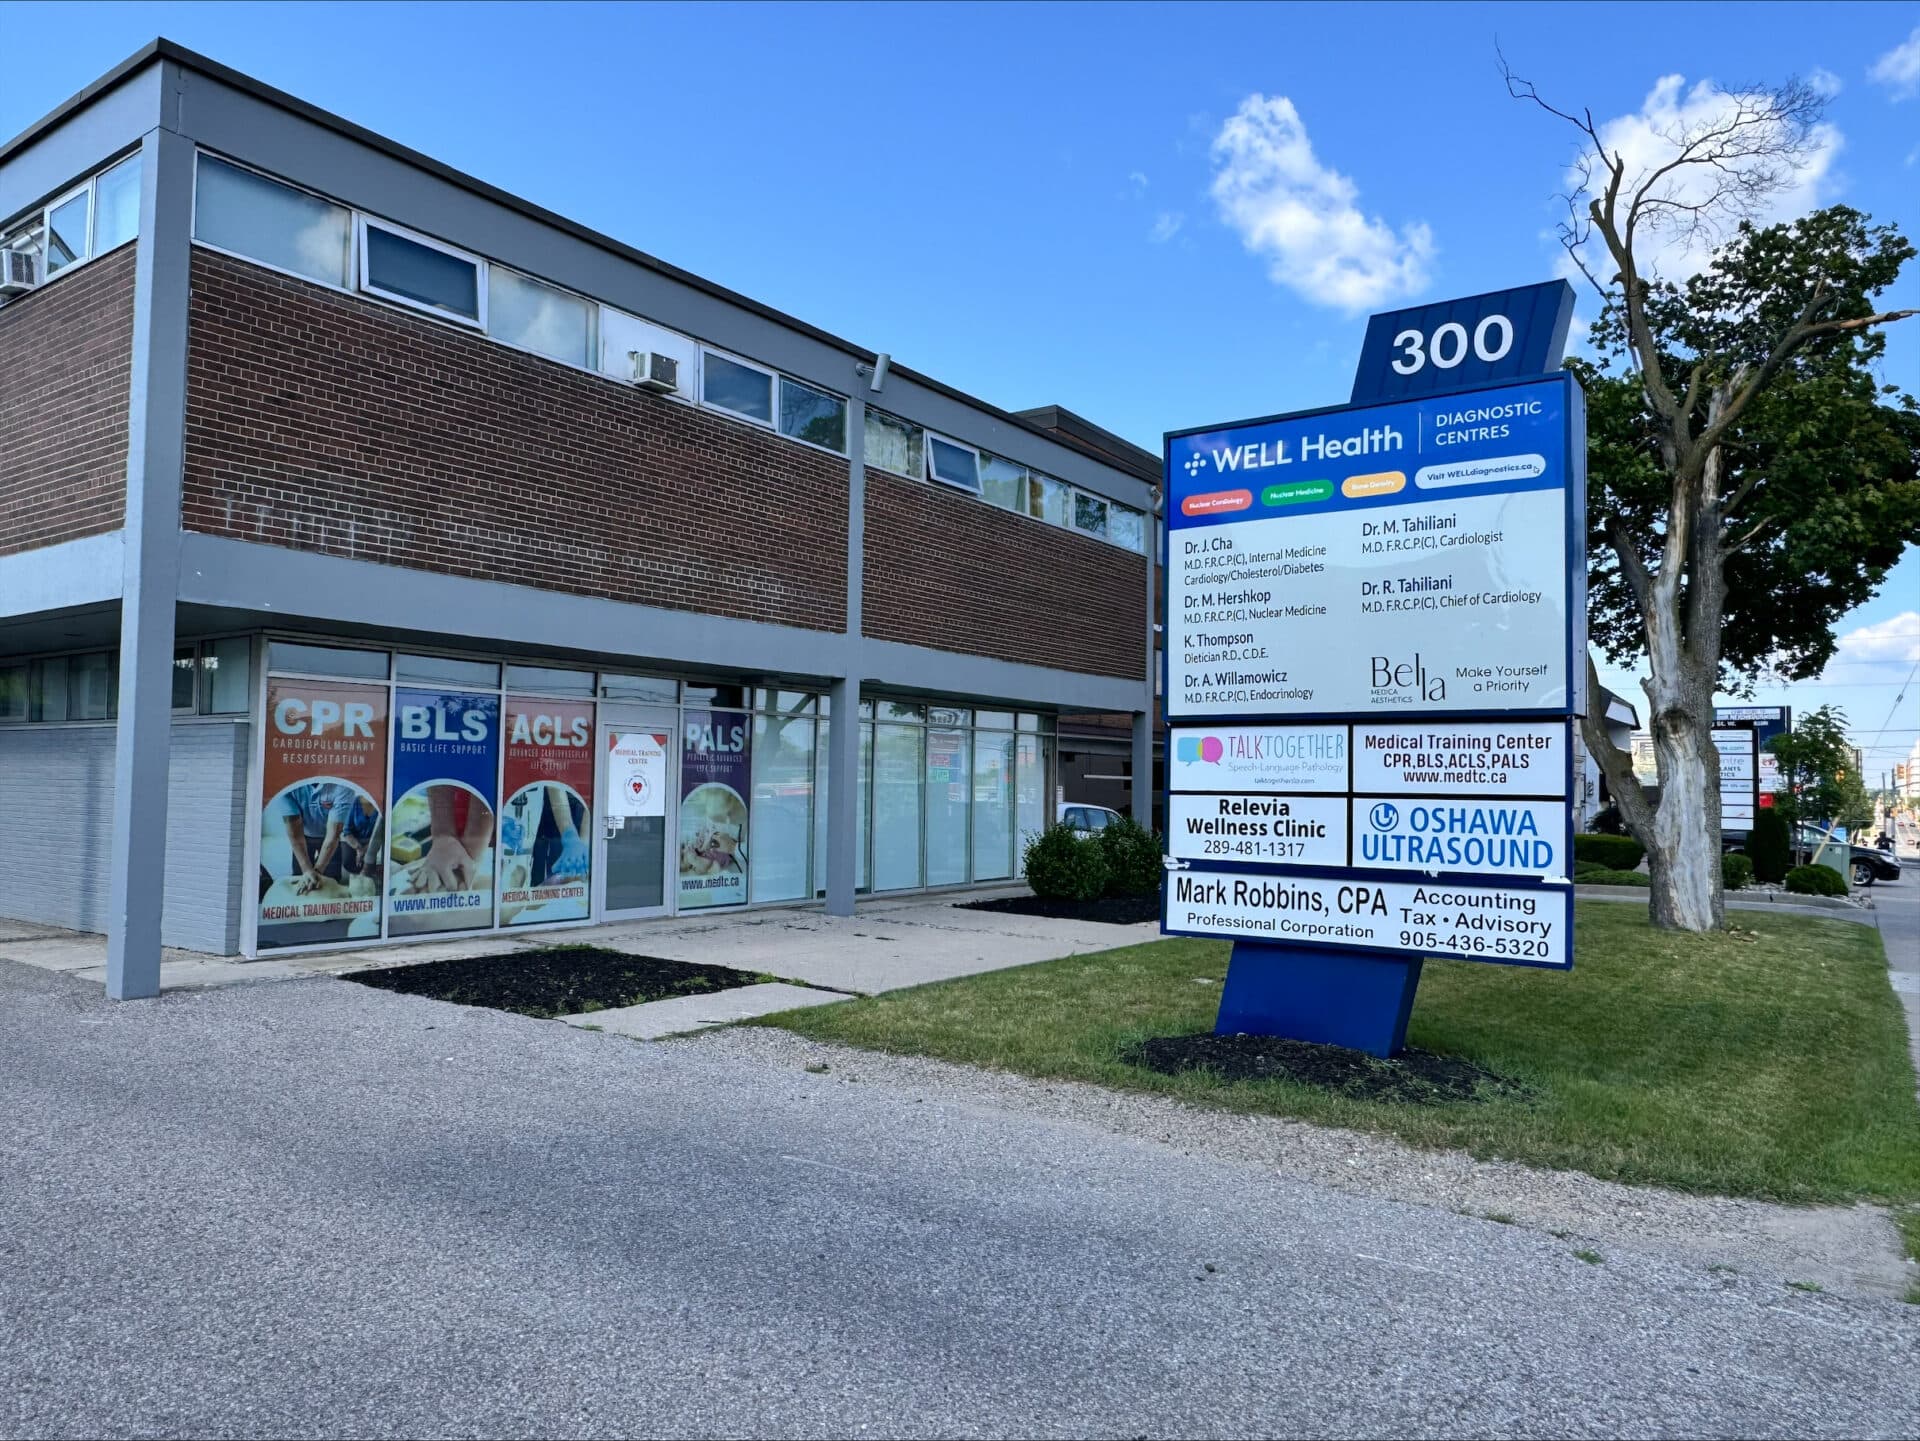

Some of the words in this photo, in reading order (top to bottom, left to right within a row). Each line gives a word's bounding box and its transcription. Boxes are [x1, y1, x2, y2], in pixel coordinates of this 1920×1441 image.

[1391, 314, 1513, 375] 300
[1436, 401, 1542, 427] DIAGNOSTIC
[1435, 424, 1510, 446] CENTRES
[1212, 440, 1292, 473] WELL
[1302, 424, 1403, 461] Health
[1427, 472, 1445, 481] Visit
[1447, 463, 1532, 478] WELLdiagnostics.ca
[1270, 490, 1294, 499] Nuclear
[1295, 486, 1325, 496] Medicine
[1189, 499, 1211, 509] Nuclear
[1362, 522, 1380, 536] Dr.
[1383, 520, 1399, 534] M.
[1402, 512, 1457, 532] Tahiliani
[1185, 541, 1200, 555] Dr.
[1202, 539, 1209, 553] J.
[1211, 536, 1233, 551] Cha
[1362, 541, 1384, 554] M.D.
[1440, 530, 1503, 547] Cardiologist
[1184, 558, 1204, 570] M.D.
[1249, 548, 1283, 563] Internal
[1285, 544, 1327, 559] Medicine
[1184, 562, 1325, 586] Cardiology/Cholesterol/Diabetes
[1362, 581, 1380, 596] Dr.
[1383, 580, 1395, 594] R.
[1397, 574, 1452, 593] Tahiliani
[1184, 595, 1200, 608] Dr.
[1202, 593, 1215, 607] M.
[1218, 589, 1271, 605] Hershkop
[1362, 601, 1384, 614] M.D.
[1440, 594, 1469, 608] Chief
[1469, 592, 1481, 606] of
[1483, 589, 1542, 605] Cardiology
[1184, 613, 1203, 624] M.D.
[1249, 607, 1283, 620] Nuclear
[1285, 604, 1327, 617] Medicine
[1184, 635, 1195, 648] K.
[1197, 632, 1254, 648] Thompson
[1184, 651, 1220, 664] Dietician
[1242, 648, 1269, 660] C.D.E.
[1184, 674, 1200, 687] Dr.
[1202, 673, 1213, 687] A.
[1215, 669, 1288, 686] Willamowicz
[1371, 652, 1446, 702] Bella
[1456, 667, 1491, 678] Make
[1496, 664, 1548, 677] Yourself
[1184, 692, 1204, 703] M.D.
[1250, 687, 1313, 701] Endocrinology
[1473, 682, 1482, 692] a
[1486, 680, 1530, 693] Priority
[1371, 696, 1413, 704] AESTHETICS
[274, 697, 375, 738] CPR
[401, 705, 488, 742] BLS
[510, 713, 589, 748] ACLS
[686, 723, 744, 752] PALS
[272, 738, 376, 752] CARDIOPULMONARY
[400, 742, 426, 753] BASIC
[429, 743, 447, 753] LIFE
[451, 744, 487, 755] SUPPORT
[1228, 734, 1344, 759] TALKTOGETHER
[1365, 734, 1423, 750] Medical
[1427, 734, 1491, 752] Training
[1496, 733, 1552, 750] Center
[282, 753, 366, 765] RESUSCITATION
[1383, 753, 1530, 770] CPR,BLS,ACLS,PALS
[1403, 770, 1507, 784] www.medtc.ca
[1219, 798, 1290, 816] Relevia
[1186, 818, 1268, 836] Wellness
[1273, 819, 1326, 838] Clinic
[1410, 806, 1538, 836] OSHAWA
[1204, 839, 1305, 857] 289-481-1317
[1362, 834, 1554, 869] ULTRASOUND
[681, 875, 740, 890] www.medtc.ca
[393, 893, 481, 913] www.medtc.ca
[502, 890, 530, 903] MEDICAL
[531, 888, 560, 901] TRAINING
[561, 886, 584, 898] CENTER
[1176, 876, 1227, 905] Mark
[1234, 880, 1330, 918] Robbins,
[1337, 886, 1388, 916] CPA
[1413, 888, 1536, 915] Accounting
[262, 904, 300, 920] MEDICAL
[303, 902, 341, 917] TRAINING
[343, 900, 374, 914] CENTER
[1187, 912, 1276, 931] Professional
[1280, 918, 1374, 938] Corporation
[1399, 907, 1436, 926] Tax
[1455, 912, 1552, 939] Advisory
[1399, 930, 1549, 957] 905-436-5320
